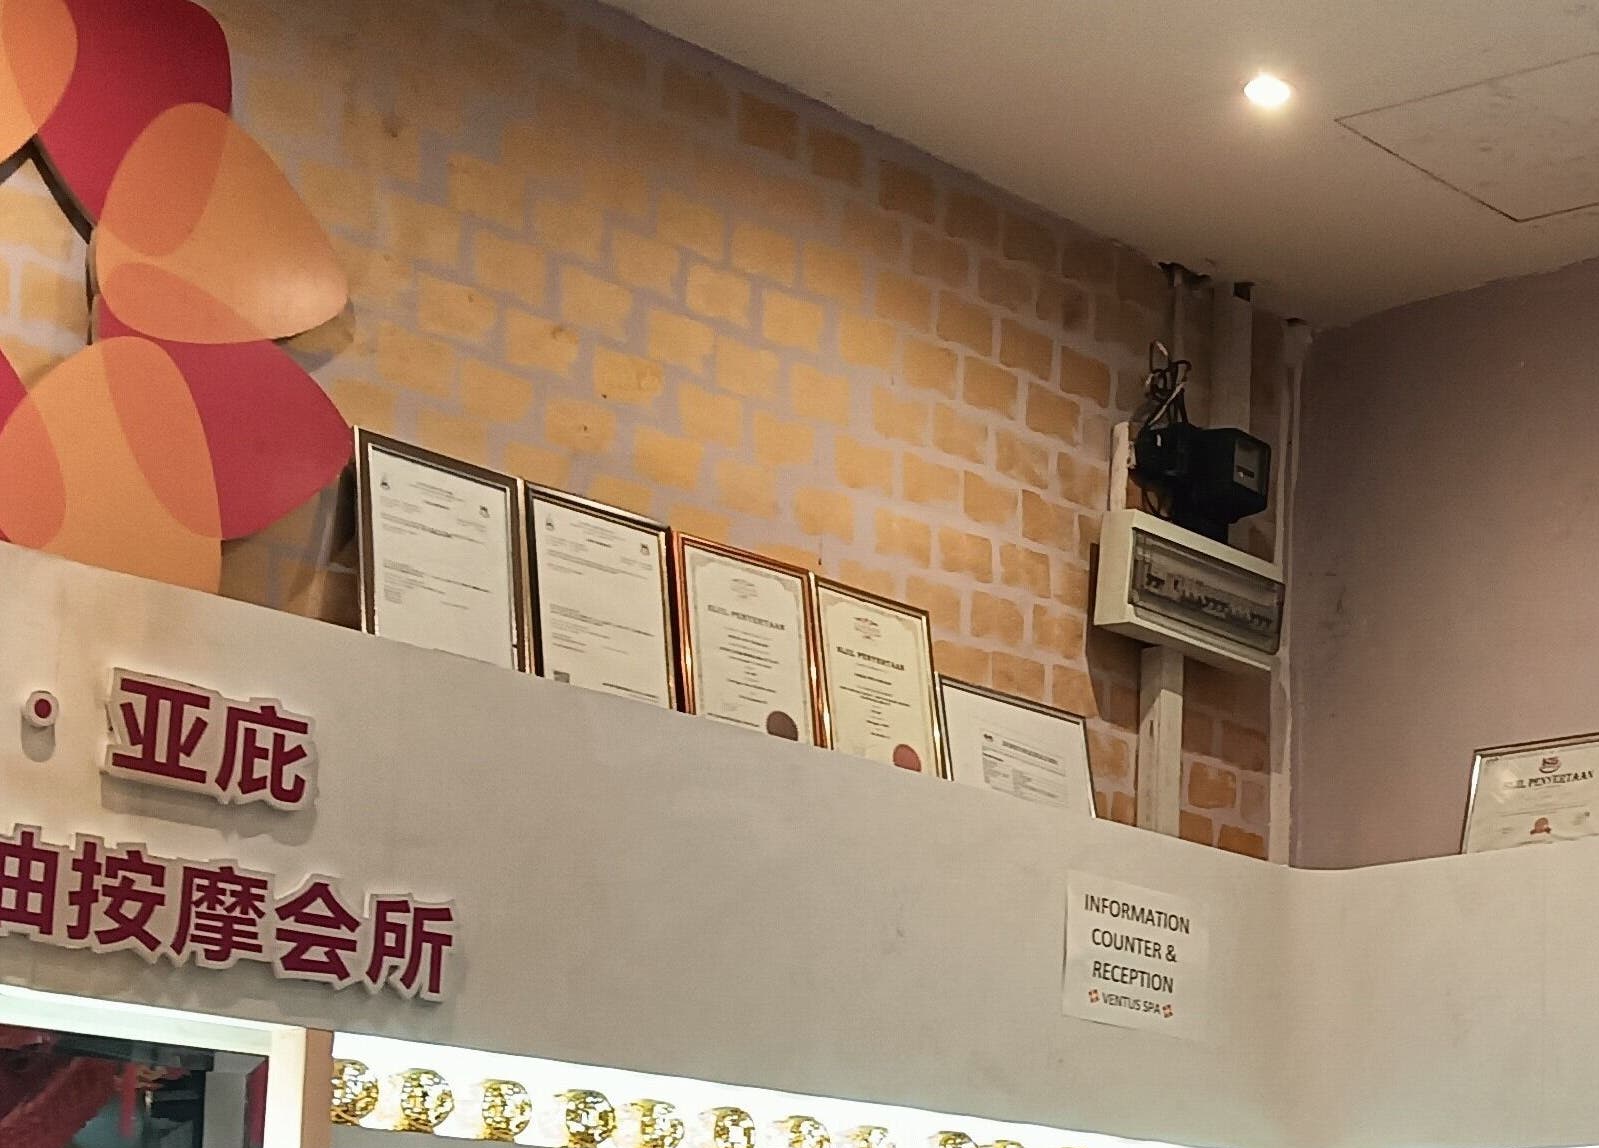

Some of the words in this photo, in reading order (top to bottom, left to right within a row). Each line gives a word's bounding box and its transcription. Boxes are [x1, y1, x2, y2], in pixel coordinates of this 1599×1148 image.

[1084, 893, 1190, 934] INFORMATION
[1092, 928, 1162, 959] COUNTER
[1165, 944, 1178, 963] &
[1092, 960, 1174, 993] RECEPTION
[1102, 992, 1141, 1011] VENTUS
[1143, 1001, 1161, 1015] SPA
